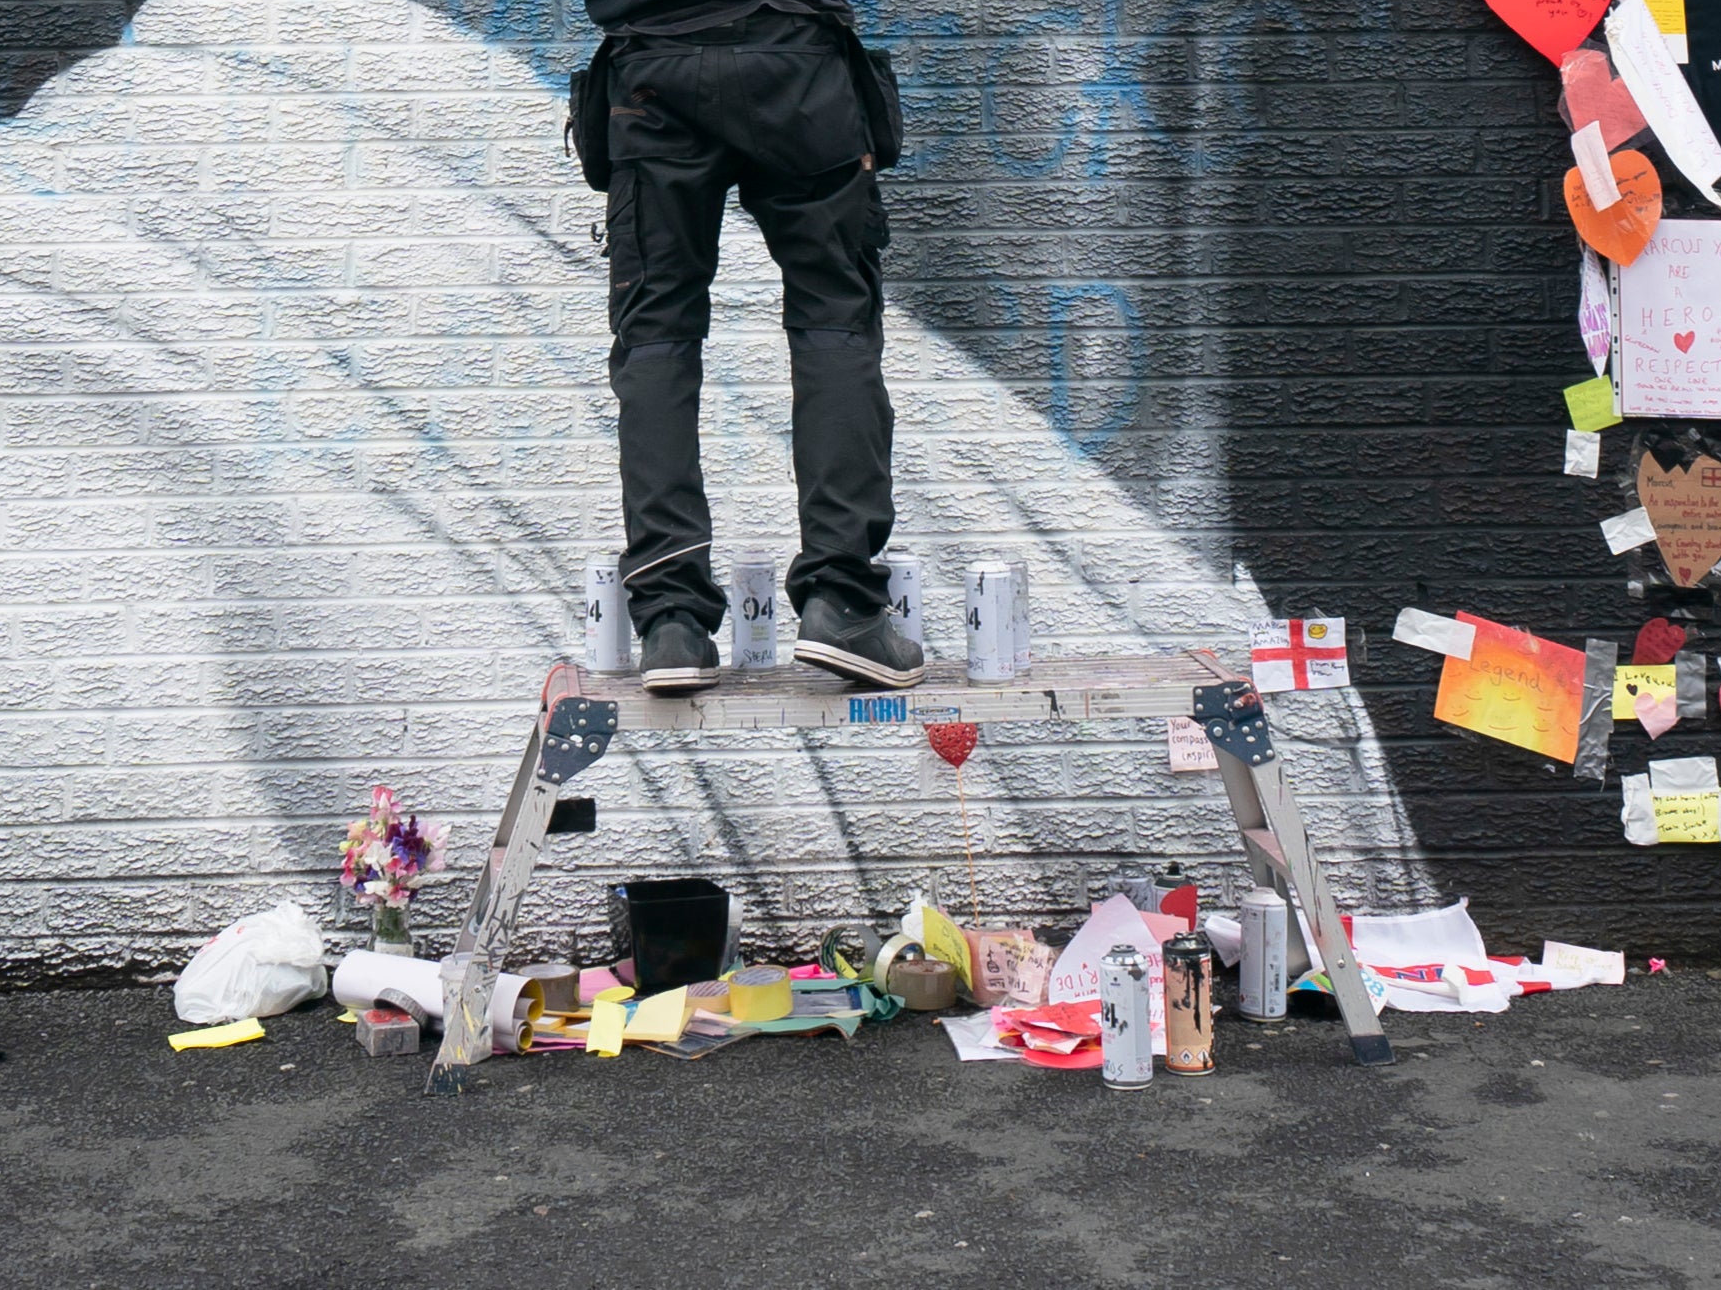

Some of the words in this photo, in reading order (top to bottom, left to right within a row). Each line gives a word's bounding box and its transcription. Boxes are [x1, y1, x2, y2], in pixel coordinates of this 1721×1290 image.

[1644, 238, 1703, 255] ARCUS
[1668, 264, 1690, 279] ARE
[743, 596, 774, 622] 94
[1467, 657, 1543, 695] Legend
